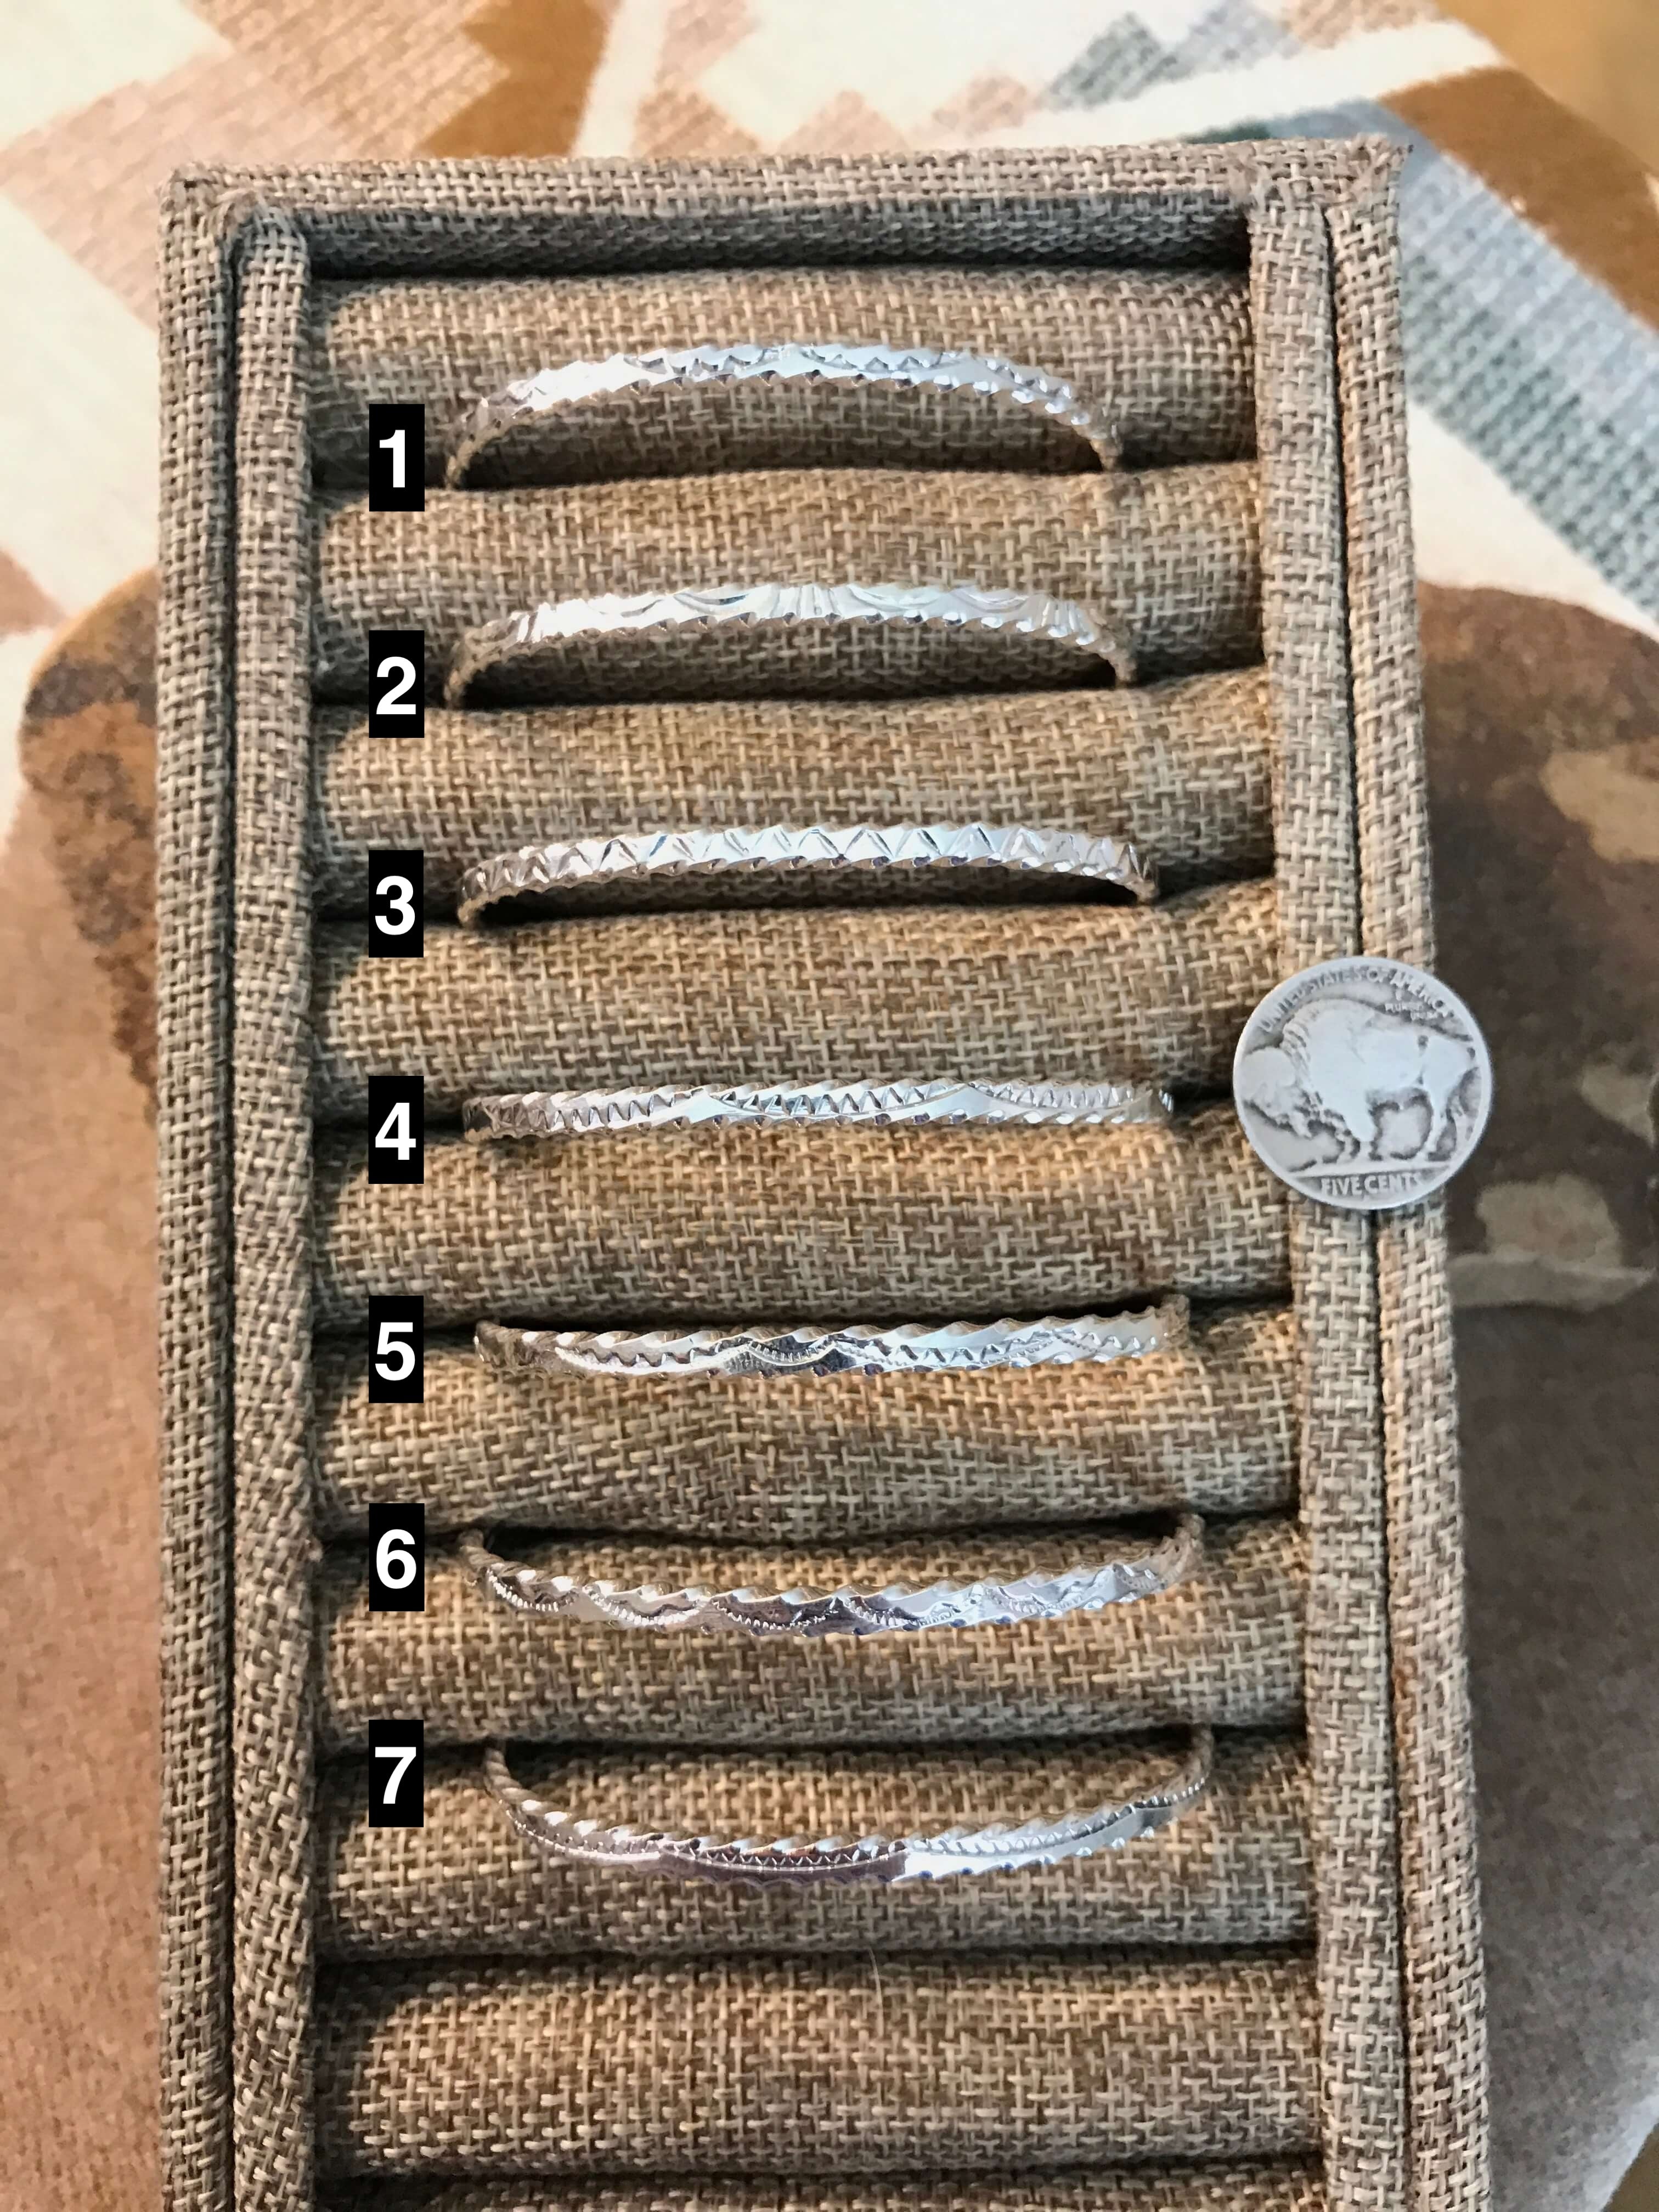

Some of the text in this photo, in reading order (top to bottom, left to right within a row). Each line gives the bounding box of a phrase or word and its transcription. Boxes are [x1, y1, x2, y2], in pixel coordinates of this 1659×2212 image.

[1259, 966, 1455, 1032] UNITED STATES OF AMERICA
[1321, 1171, 1422, 1196] FIVE CENTS
